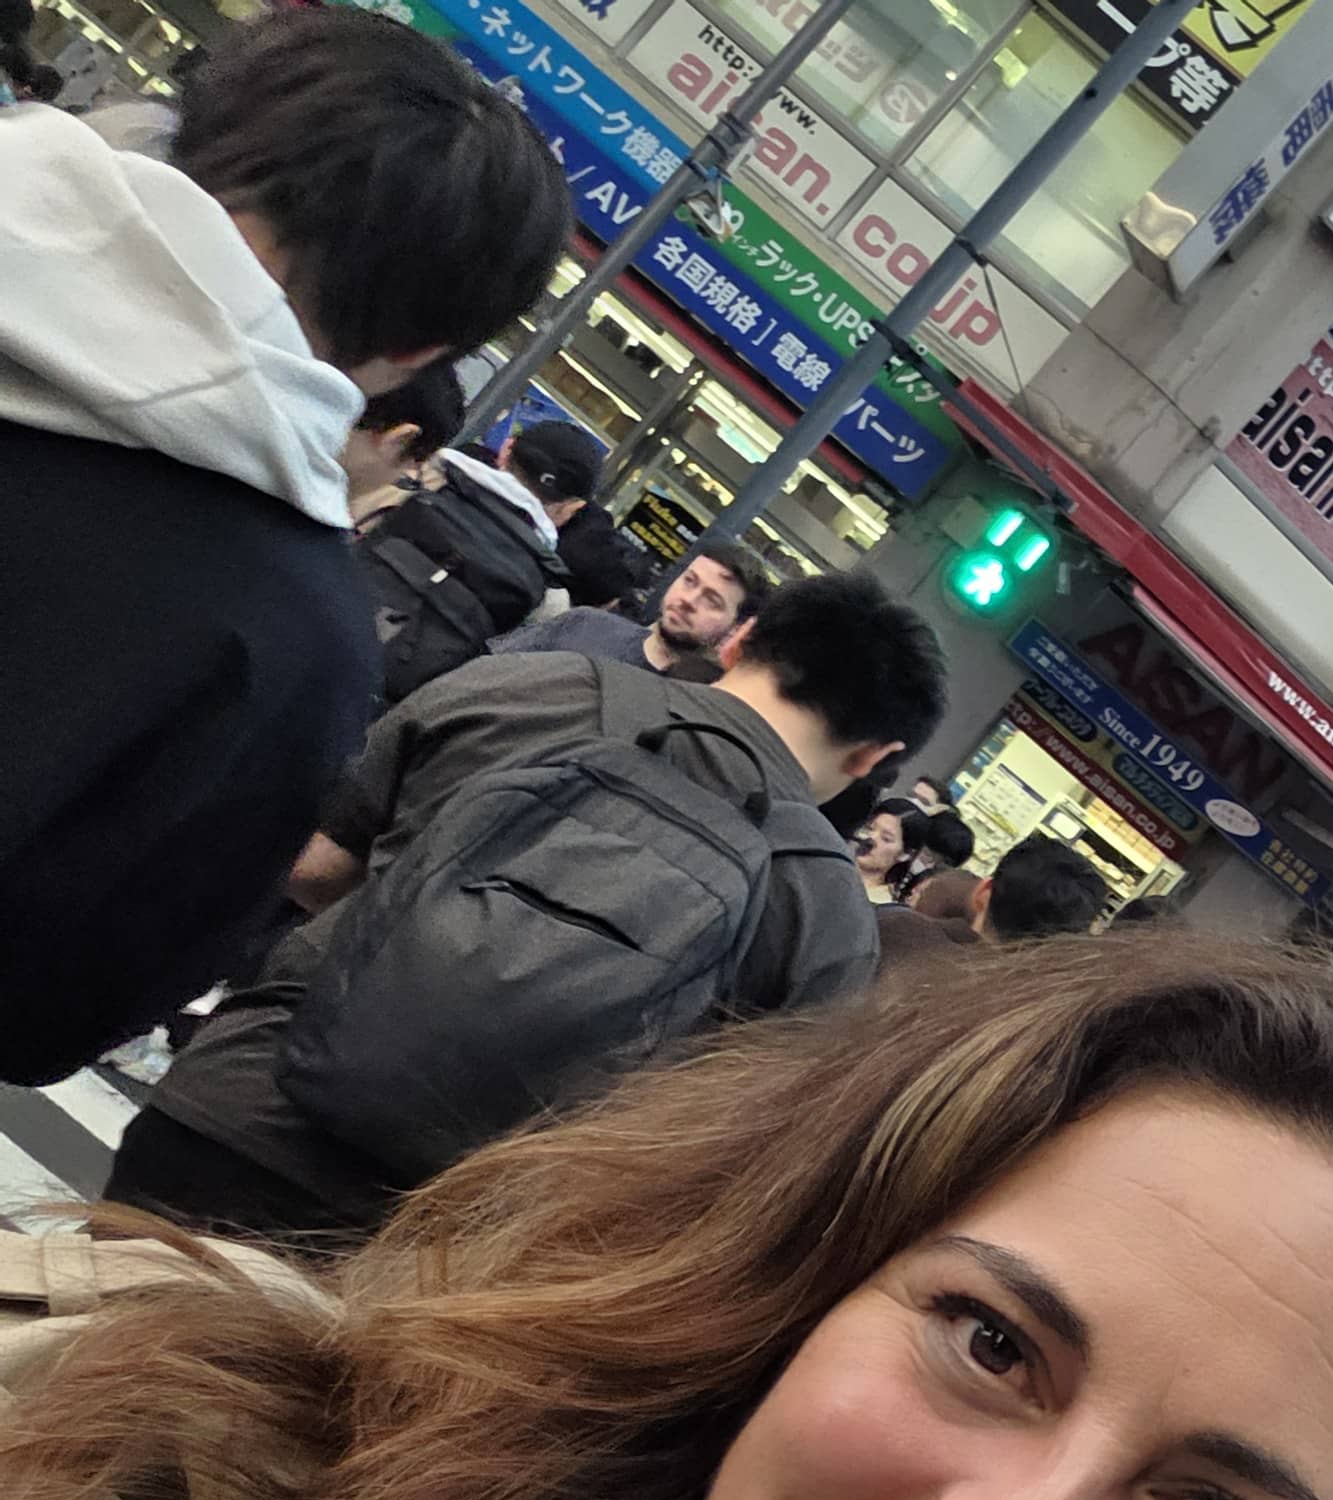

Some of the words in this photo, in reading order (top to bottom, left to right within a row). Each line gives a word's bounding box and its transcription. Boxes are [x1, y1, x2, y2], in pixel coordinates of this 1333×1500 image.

[665, 51, 833, 217] aian.
[1096, 703, 1145, 752] Since
[1137, 730, 1207, 797] 1949
